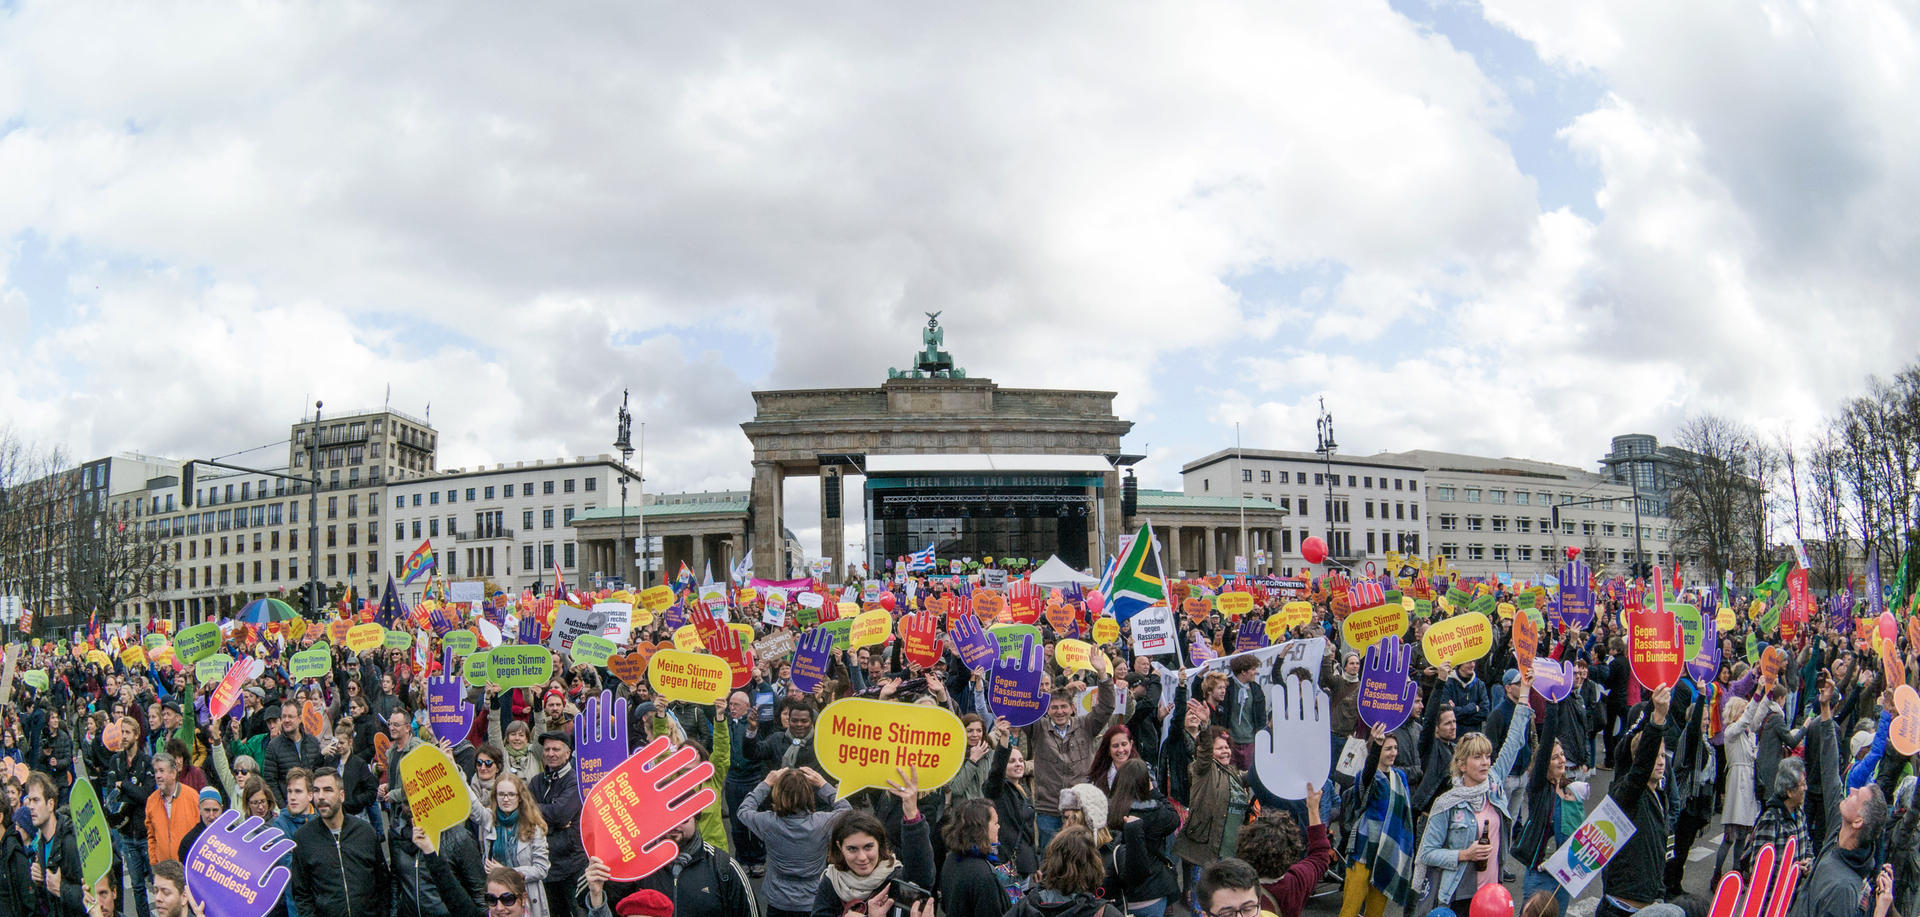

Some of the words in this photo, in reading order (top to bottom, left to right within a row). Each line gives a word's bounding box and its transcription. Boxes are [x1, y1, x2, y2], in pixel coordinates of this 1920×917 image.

[906, 479, 940, 487] GEGEN
[950, 478, 975, 486] HASS
[984, 478, 1004, 486] UND
[1013, 478, 1069, 486] RASSISMUS
[565, 618, 598, 630] Aufstehen
[866, 618, 886, 626] Stimme
[1349, 620, 1372, 632] Meine
[1373, 612, 1400, 626] Stimme
[363, 629, 380, 637] Stimme
[868, 626, 883, 634] Hetze
[1138, 632, 1168, 640] Rassismus!
[1355, 631, 1379, 642] gegen
[1379, 623, 1399, 635] Hetze
[1429, 632, 1455, 647] Meine
[1455, 623, 1485, 638] Stimme
[1634, 625, 1657, 637] Gegen
[178, 635, 195, 648] Meine
[195, 629, 217, 641] Stimme
[353, 638, 366, 646] gegen
[1634, 638, 1671, 649] Rassismus
[1685, 635, 1695, 645] etze
[183, 645, 199, 658] gegen
[201, 639, 215, 650] Hetze
[762, 641, 791, 659] Gewalt
[1062, 644, 1083, 654] Meine
[1437, 643, 1463, 658] gegen
[1463, 636, 1483, 649] Hetze
[294, 657, 307, 665] Meine
[492, 655, 516, 666] Meine
[517, 654, 546, 665] Stimme
[1634, 651, 1644, 662] im
[1646, 651, 1678, 664] Bundestag
[496, 667, 520, 678] gegen
[522, 665, 543, 676] Hetze
[657, 658, 684, 674] Meine
[687, 663, 723, 680] Stimme
[660, 673, 688, 689] gegen
[690, 677, 717, 692] Hetze
[995, 675, 1018, 688] Gegen
[1366, 678, 1387, 689] Gegen
[430, 694, 443, 704] Gegen
[994, 686, 1032, 699] Rassismus
[1364, 688, 1398, 701] Rassismus
[992, 694, 1001, 704] im
[1002, 696, 1040, 709] Bundestag
[1361, 699, 1371, 708] im
[1372, 700, 1404, 712] Bundestag
[430, 704, 455, 713] Rassismus
[436, 713, 463, 725] Bundestag
[832, 714, 883, 740] Meine
[888, 722, 951, 747] Stimme
[839, 743, 890, 767] gegen
[895, 746, 940, 769] Hetze
[580, 758, 601, 771] Gegen
[416, 762, 447, 788] Stimme
[428, 785, 455, 806] Hetze
[616, 772, 640, 807] Gegen
[603, 780, 640, 838] Rassismus
[592, 790, 603, 808] im
[598, 804, 636, 862] Bundestag
[84, 826, 101, 852] Hetze
[1582, 823, 1615, 855] STOPPT
[207, 834, 238, 858] Gegen
[1574, 842, 1599, 867] AFD
[198, 845, 251, 881] Rassismus
[191, 858, 205, 874] im
[205, 863, 258, 905] Bundestag
